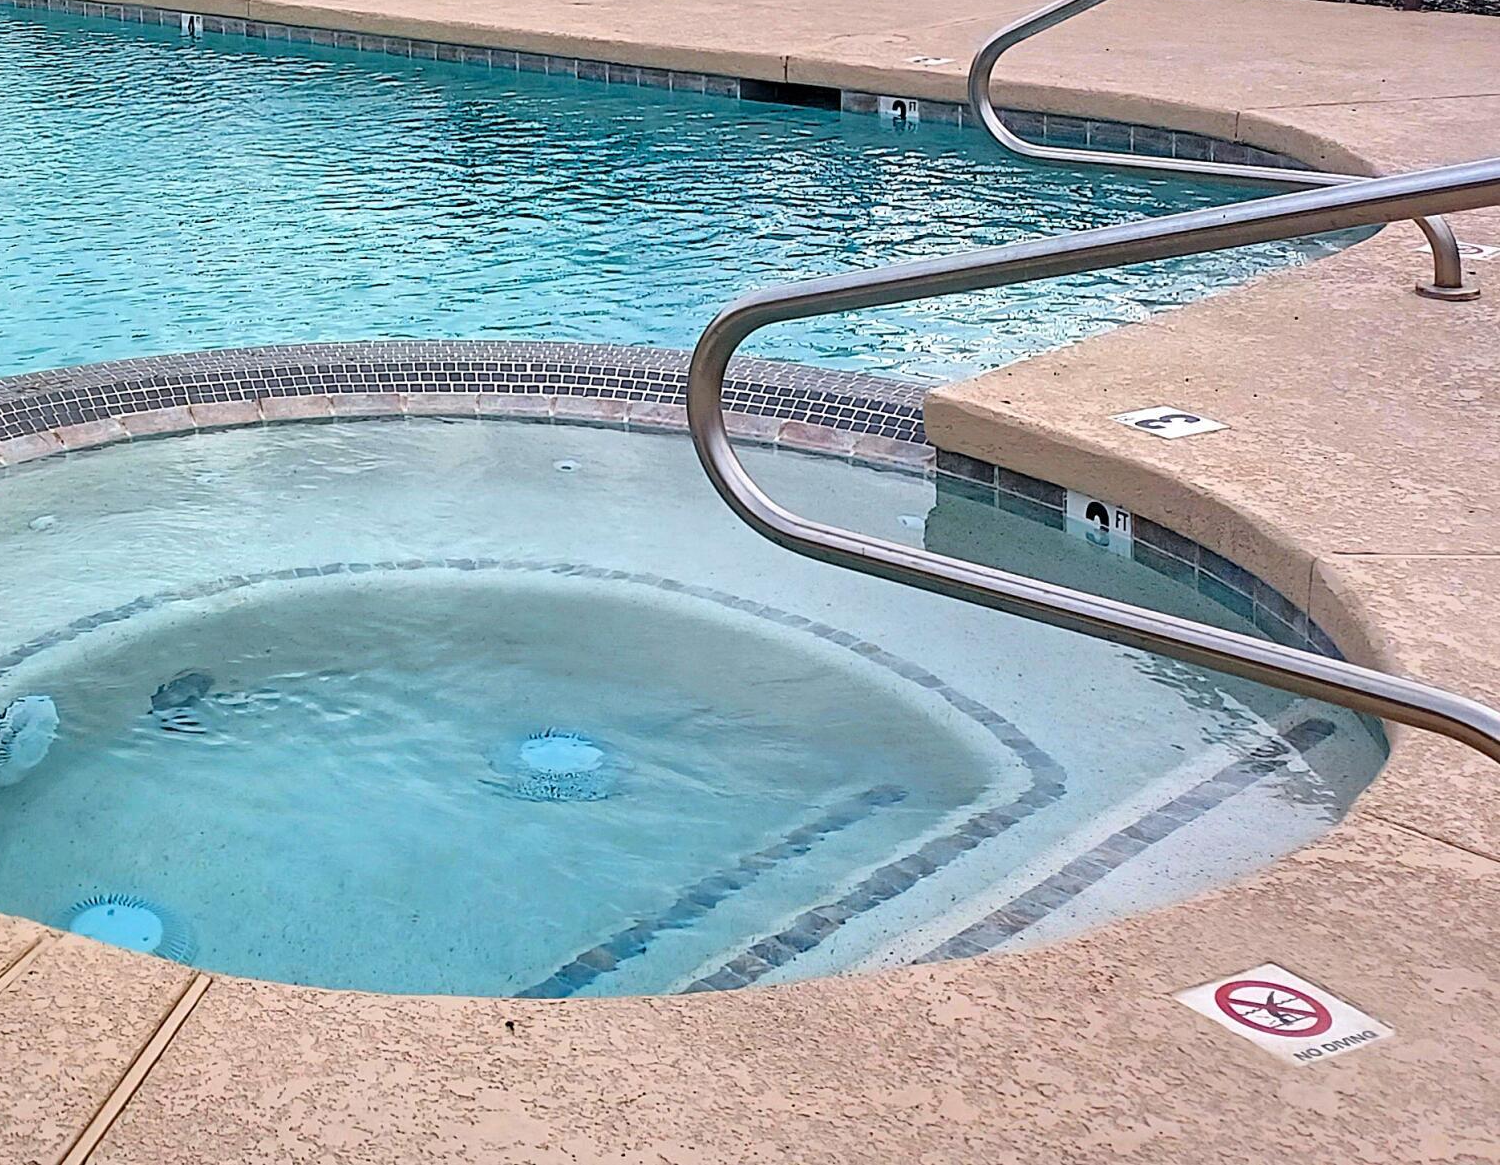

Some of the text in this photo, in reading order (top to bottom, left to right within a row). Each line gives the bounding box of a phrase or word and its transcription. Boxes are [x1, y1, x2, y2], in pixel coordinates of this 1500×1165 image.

[1135, 413, 1201, 430] 3
[1116, 510, 1129, 532] FT
[1293, 1030, 1380, 1062] NO DIVING
